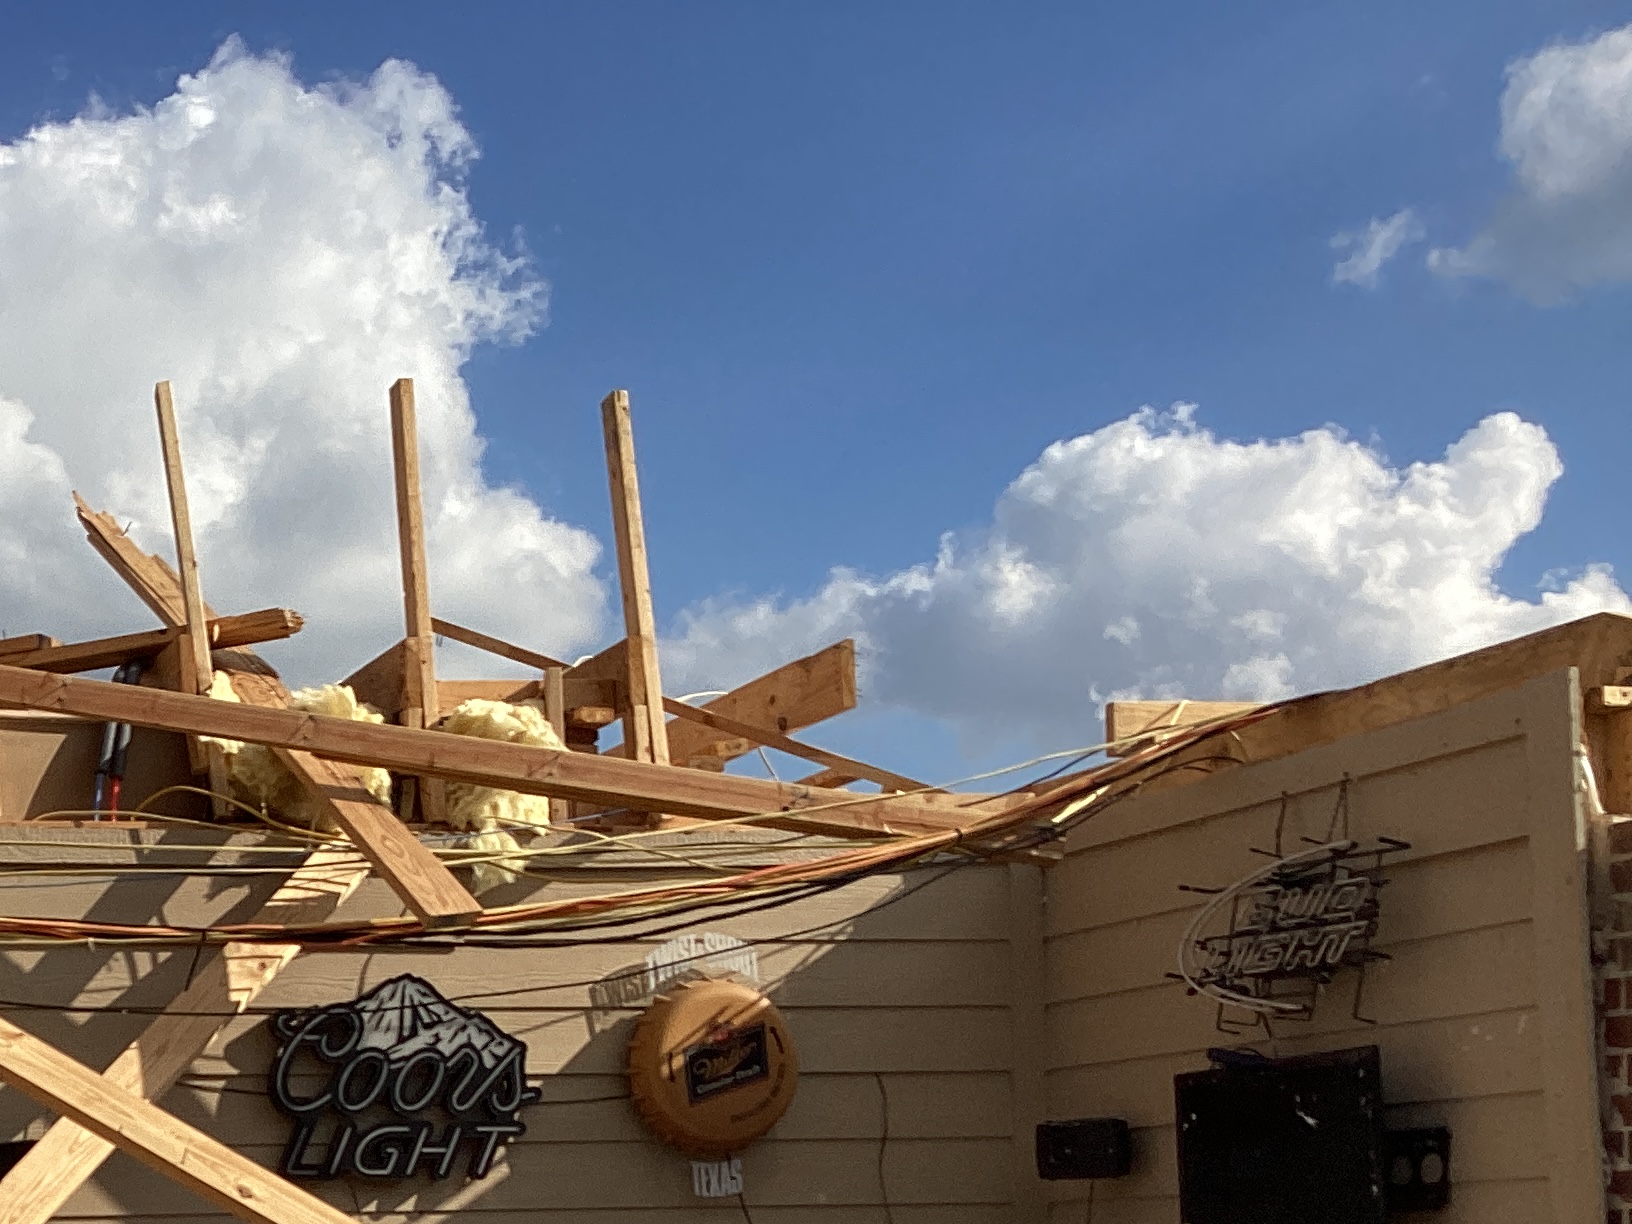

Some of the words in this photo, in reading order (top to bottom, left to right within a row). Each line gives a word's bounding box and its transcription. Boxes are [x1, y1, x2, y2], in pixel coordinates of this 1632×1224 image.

[645, 933, 697, 991] TWIST
[275, 1007, 538, 1112] Coors
[286, 1125, 523, 1176] LIGHT
[691, 1160, 744, 1198] TEXAS
